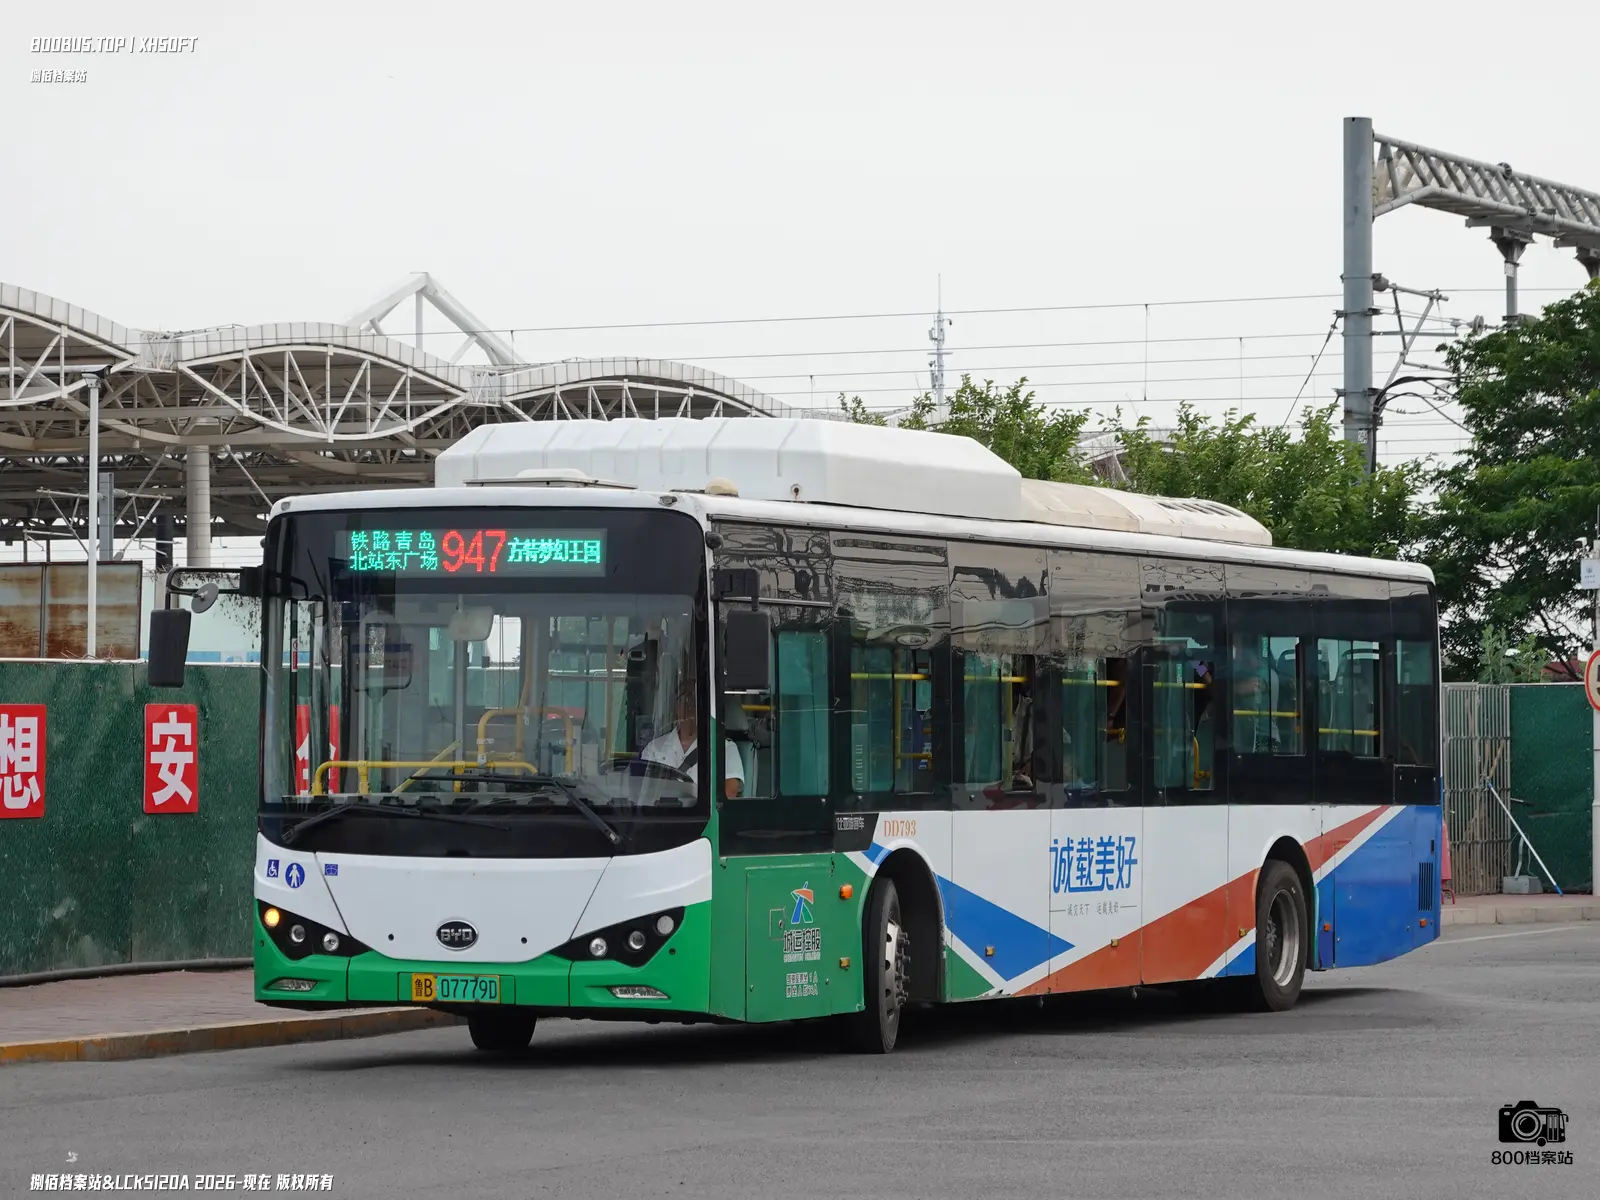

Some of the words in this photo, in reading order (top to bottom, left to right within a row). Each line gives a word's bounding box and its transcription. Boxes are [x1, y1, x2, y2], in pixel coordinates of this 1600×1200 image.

[351, 531, 435, 550] 铁路青岛
[442, 530, 506, 571] 947
[507, 537, 601, 564] 方特梦幻王国
[350, 551, 438, 570] 北站东广场
[150, 712, 194, 806] 安
[884, 820, 916, 837] DD793
[1049, 835, 1138, 893] 诚载美好
[440, 928, 473, 942] BYD
[783, 928, 820, 953] 城运控股
[414, 978, 433, 997] 鲁B
[441, 979, 498, 999] 07779D
